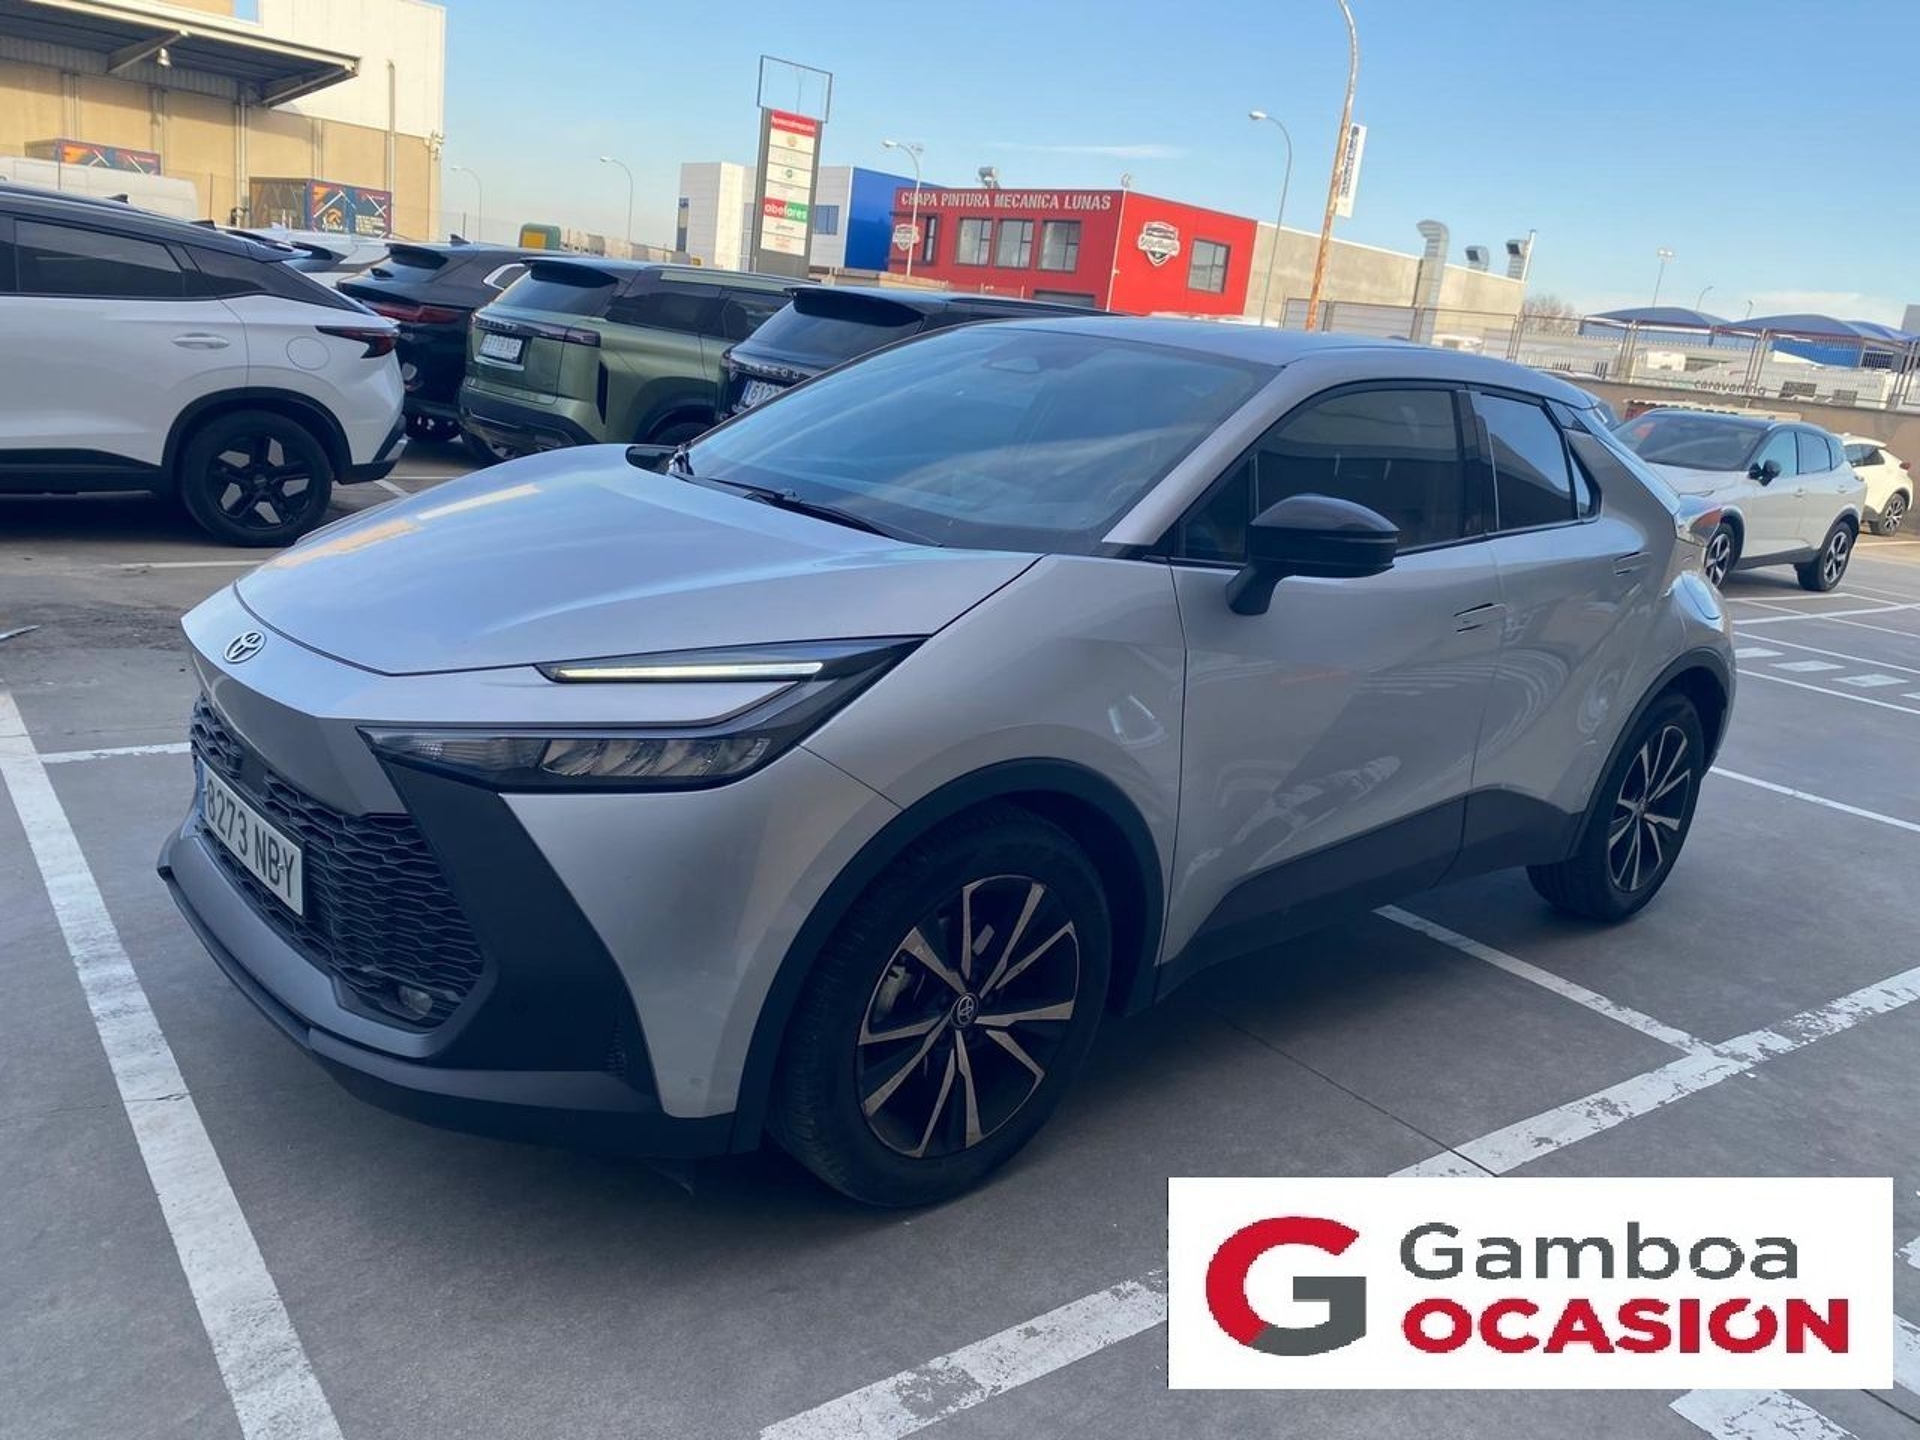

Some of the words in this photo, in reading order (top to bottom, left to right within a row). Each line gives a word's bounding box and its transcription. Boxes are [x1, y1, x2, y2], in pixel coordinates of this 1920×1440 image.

[901, 191, 938, 207] CHAPA
[941, 192, 991, 208] PINTURA
[994, 193, 1060, 210] MECANICA
[1064, 194, 1111, 211] LUNAS
[206, 778, 249, 857] 8273
[254, 823, 295, 899] NBY
